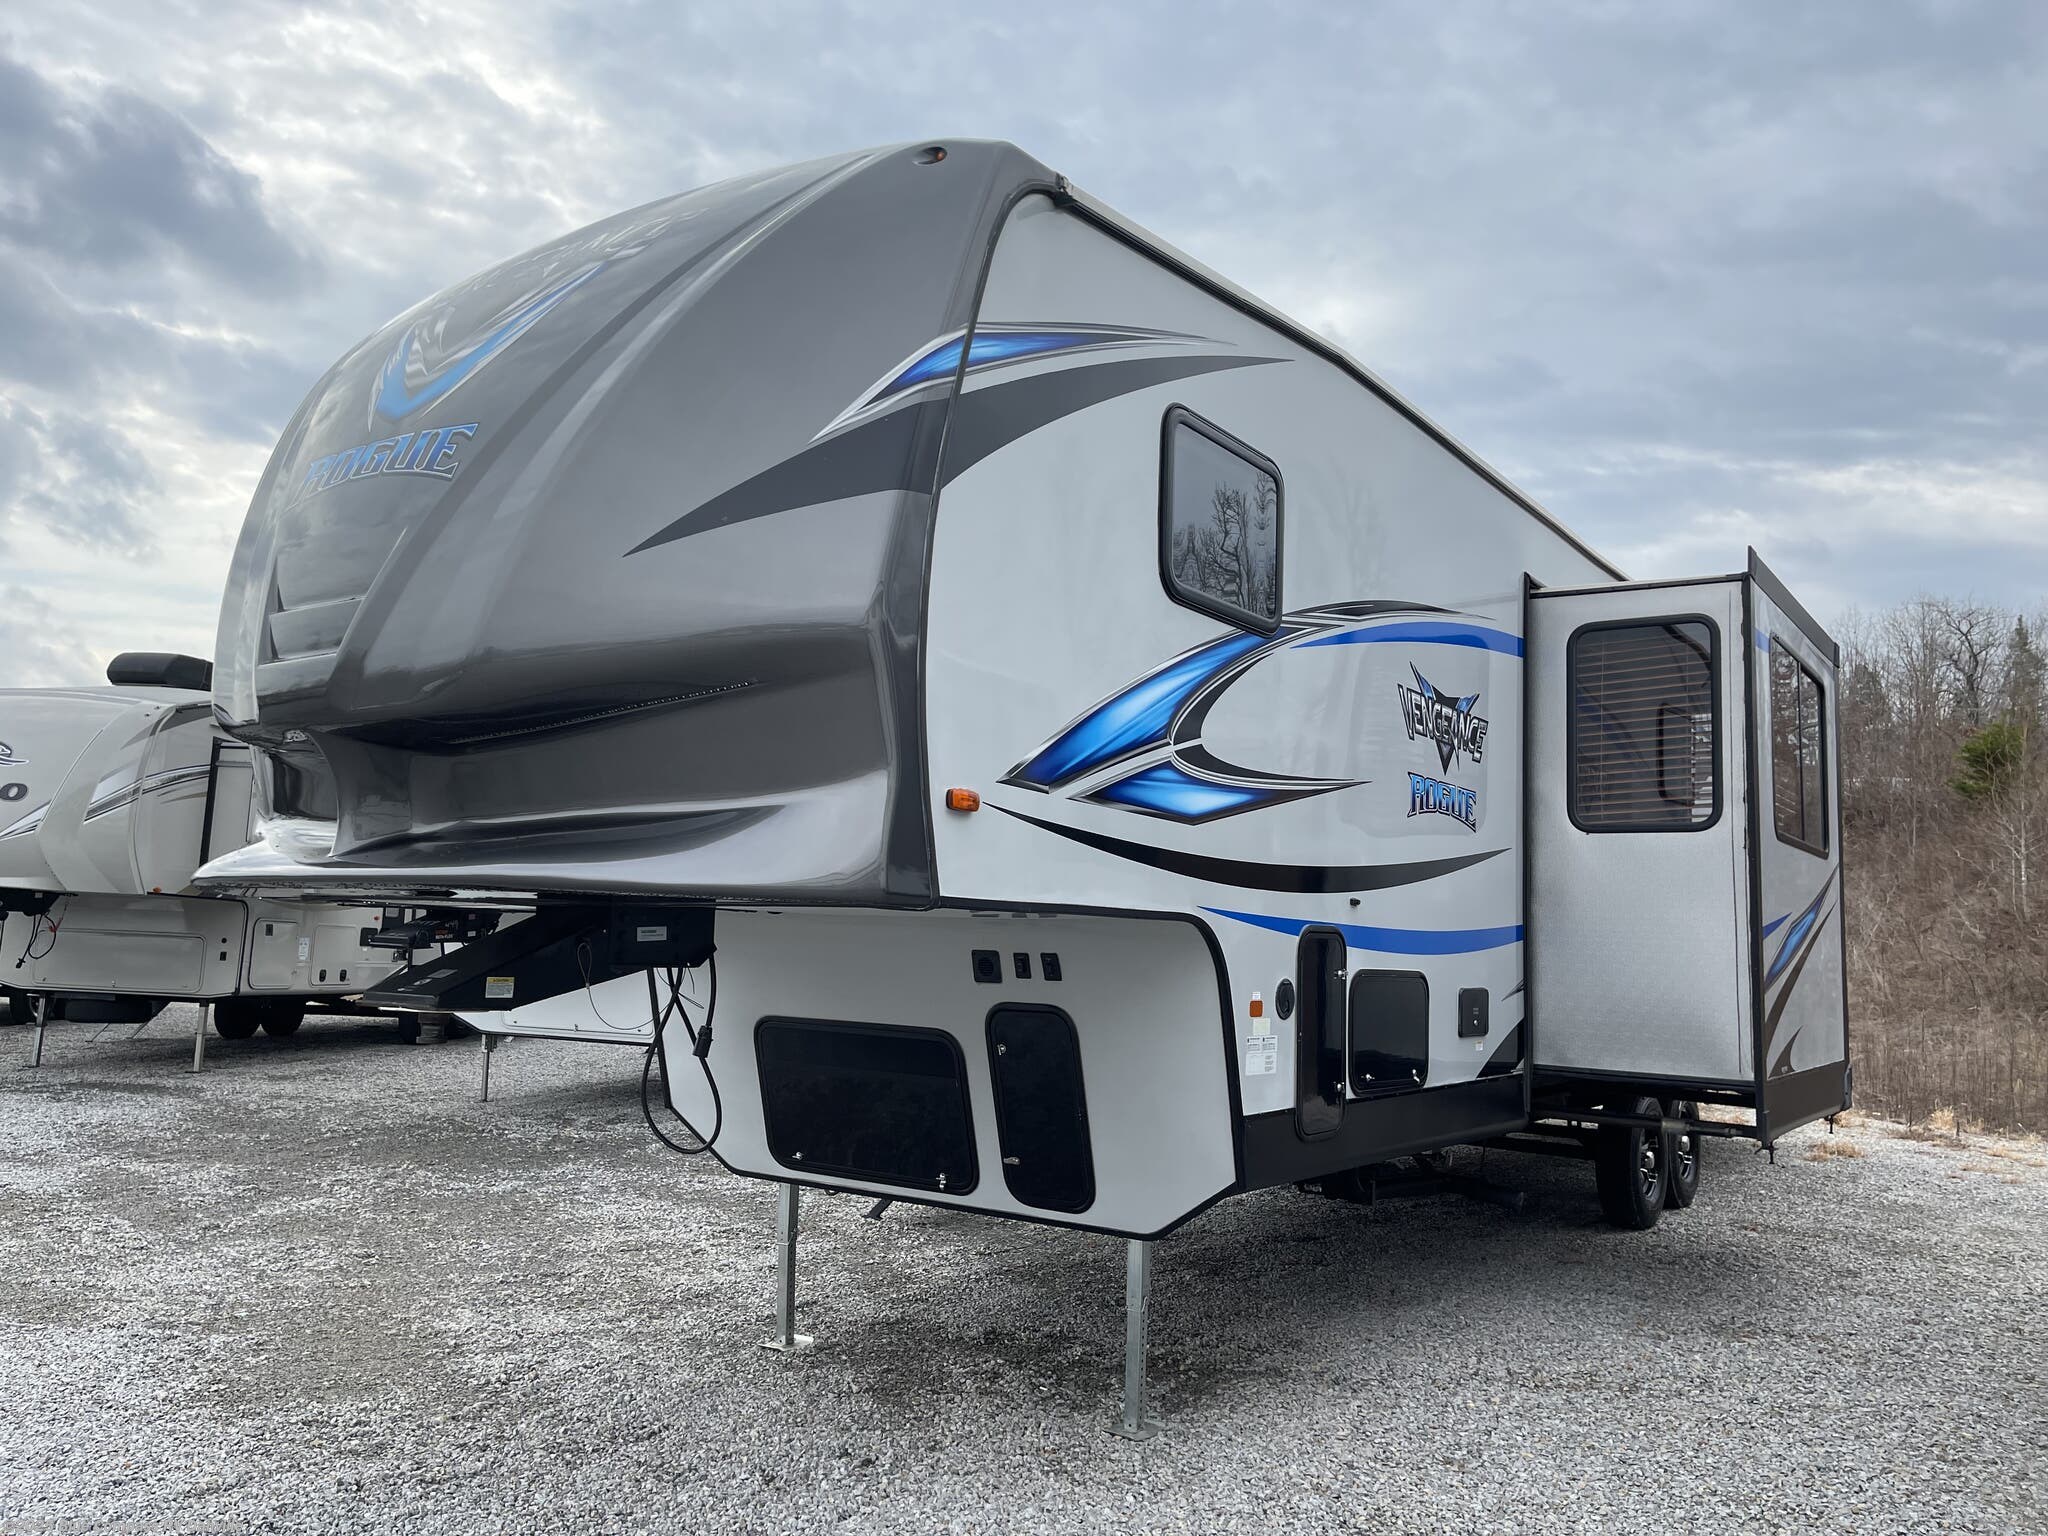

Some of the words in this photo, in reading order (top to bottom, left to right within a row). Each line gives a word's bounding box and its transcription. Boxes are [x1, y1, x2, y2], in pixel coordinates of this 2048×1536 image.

[284, 423, 479, 511] ROGUE
[1397, 683, 1489, 764] VENGEANCE
[1407, 771, 1477, 833] ROGUE
